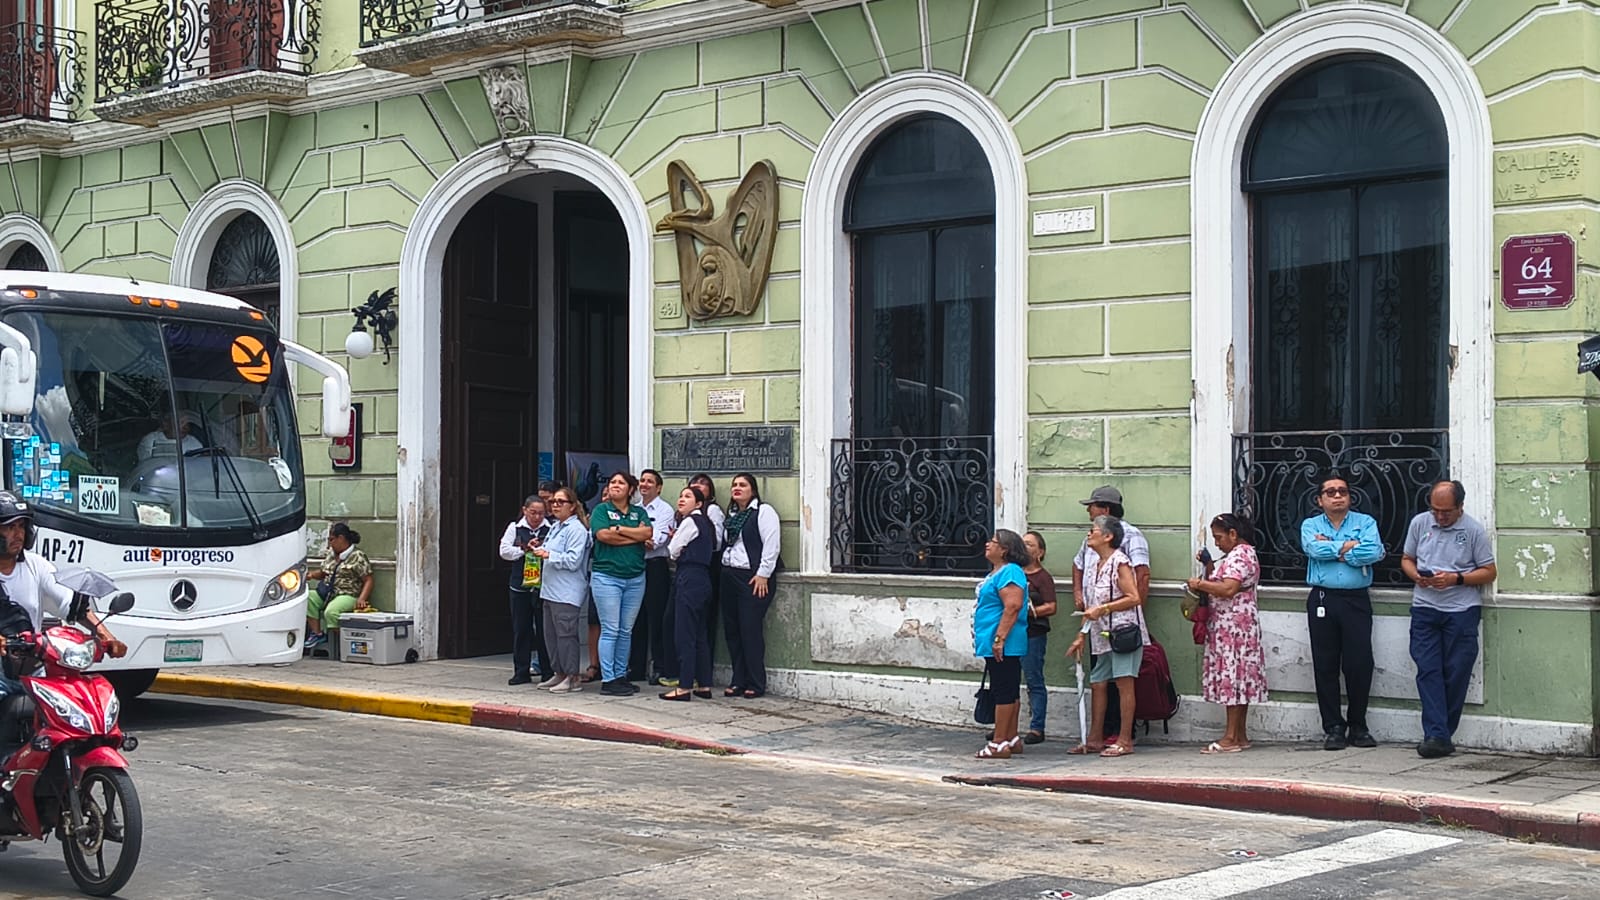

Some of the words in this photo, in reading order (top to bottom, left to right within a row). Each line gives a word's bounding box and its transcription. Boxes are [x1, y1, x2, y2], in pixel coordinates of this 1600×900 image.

[1521, 256, 1553, 280] 64
[659, 301, 679, 316] 491
[81, 490, 116, 511] $28.00
[41, 538, 84, 563] AP-27
